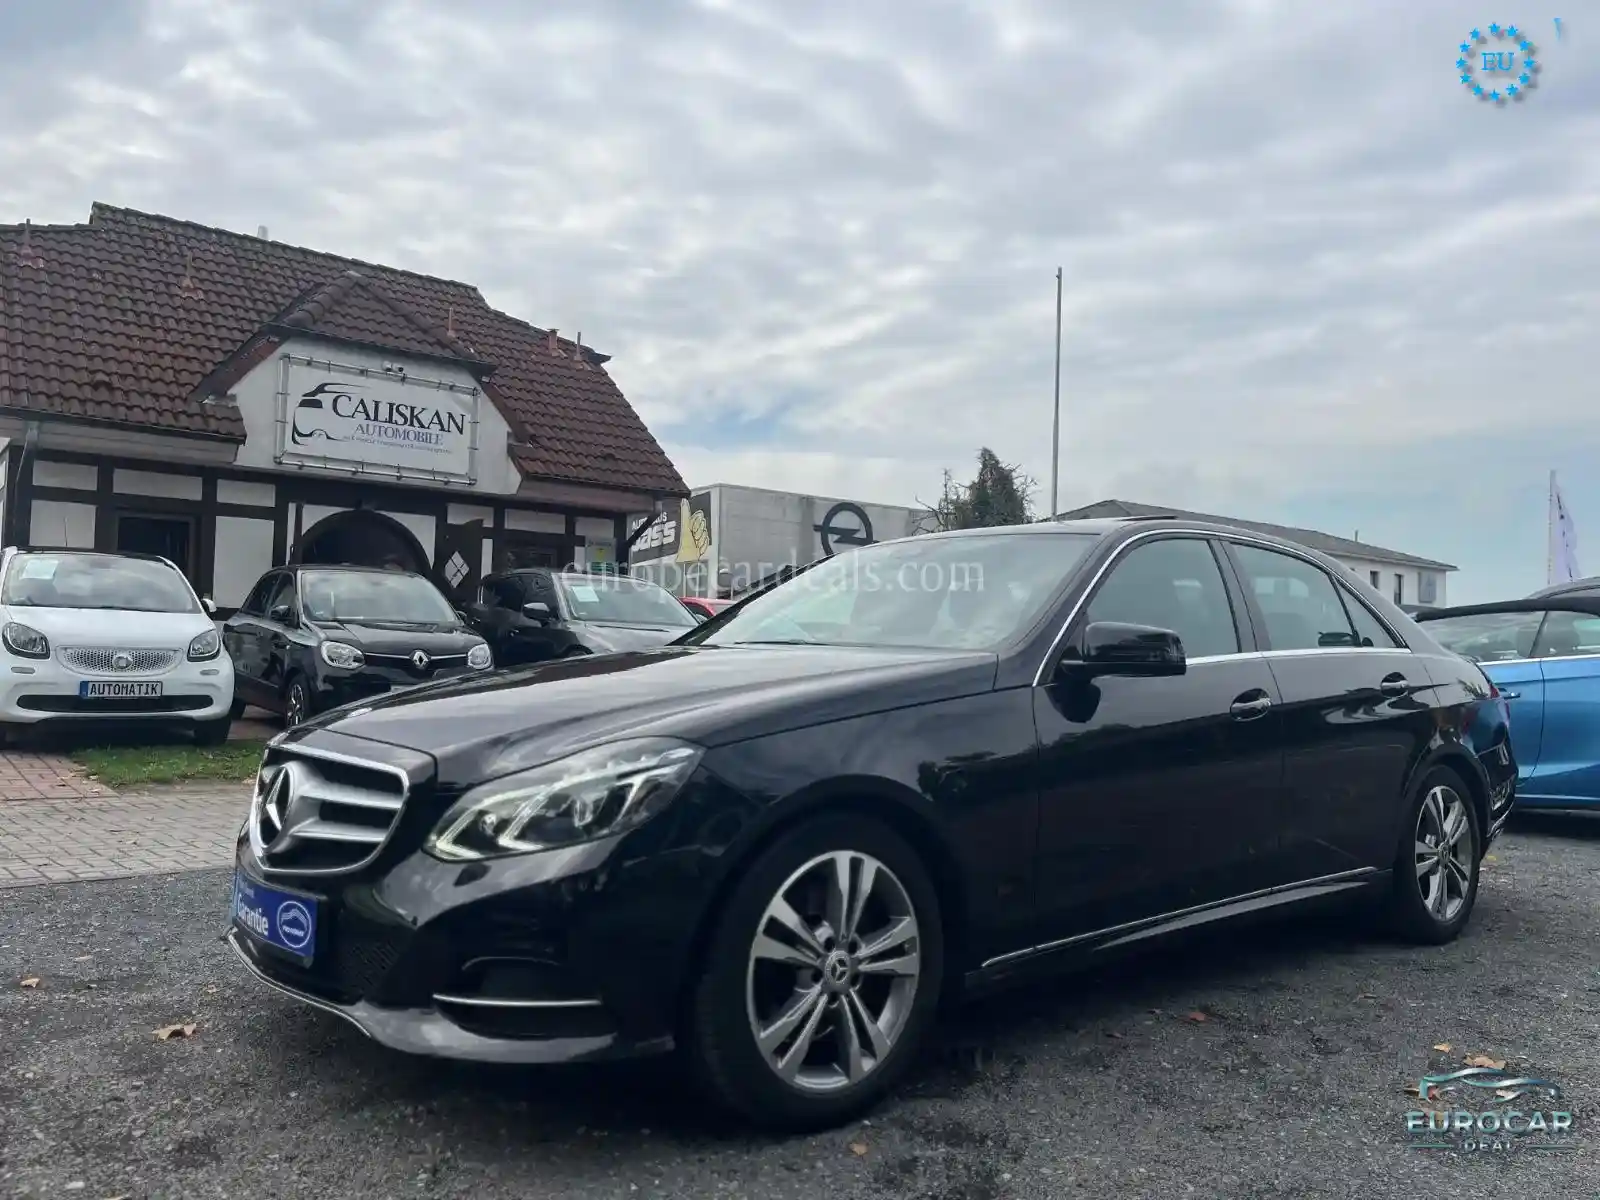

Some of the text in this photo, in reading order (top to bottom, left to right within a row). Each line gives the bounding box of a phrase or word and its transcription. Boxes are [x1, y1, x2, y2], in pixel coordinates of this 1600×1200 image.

[332, 394, 466, 435] CALISKAN
[355, 423, 444, 446] AUTOMOBILE
[90, 683, 158, 696] AUTOMATIK
